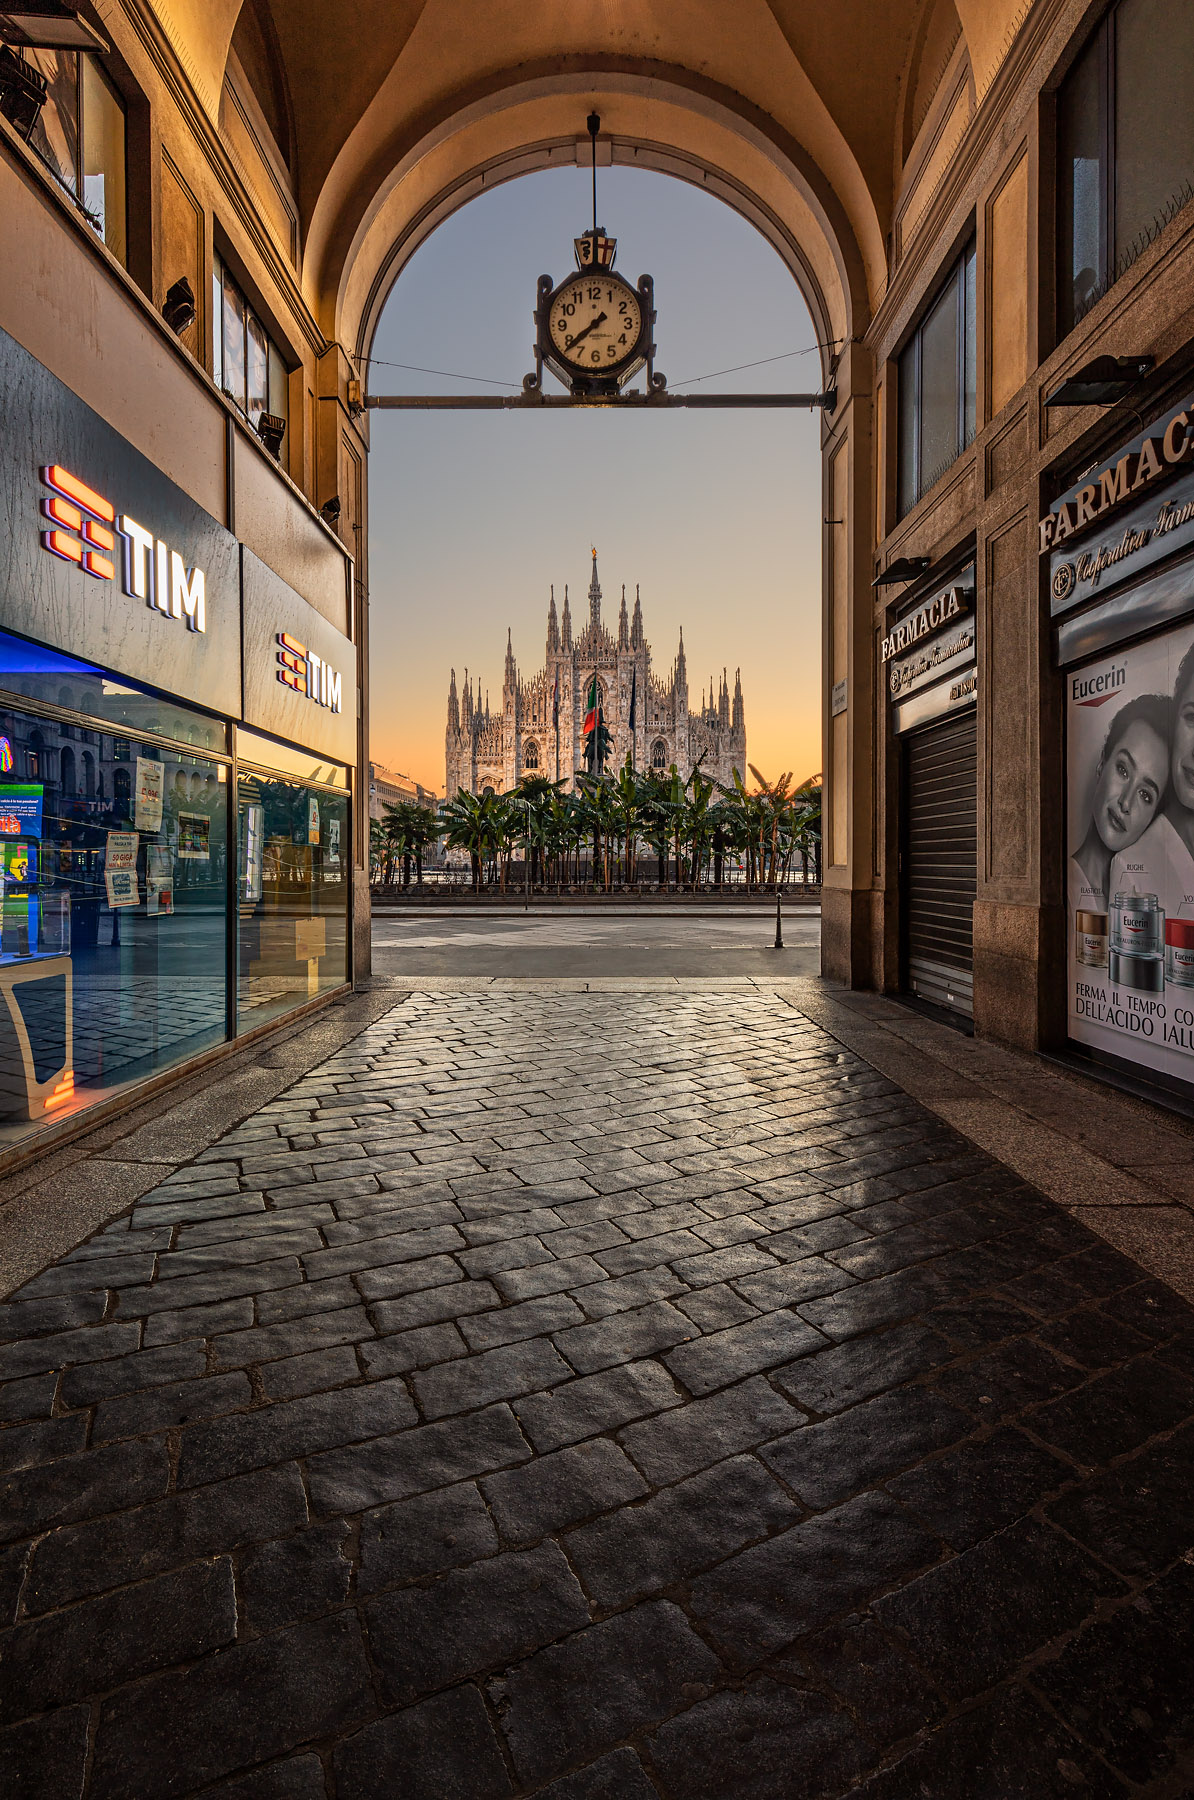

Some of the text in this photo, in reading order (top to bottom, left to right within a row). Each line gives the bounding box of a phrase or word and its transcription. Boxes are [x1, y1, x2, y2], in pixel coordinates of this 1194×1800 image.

[572, 292, 583, 304] 11
[587, 287, 601, 300] 12
[606, 290, 613, 303] 1
[561, 303, 576, 316] 10
[619, 302, 627, 315] 2
[558, 319, 567, 332] 9
[624, 318, 633, 330] 3
[565, 335, 574, 348] 8
[618, 333, 627, 346] 4
[576, 346, 586, 359] 7
[591, 350, 601, 363] 6
[607, 345, 616, 358] 5
[1038, 403, 1194, 556] FARMAC
[1076, 529, 1148, 586] Cooperativa
[116, 514, 206, 633] TIM
[881, 587, 960, 663] FARMACIA
[306, 650, 342, 713] TIM
[89, 802, 113, 812] TIM
[1126, 863, 1145, 871] RUGHE
[1183, 895, 1194, 903] VO
[1123, 916, 1149, 928] Eucerin
[1085, 937, 1102, 946] Eucerin
[1076, 982, 1107, 1002] FERMA
[1113, 992, 1121, 1006] IL
[1127, 995, 1167, 1019] TEMPO
[1076, 998, 1154, 1036] DELL'ACIDO
